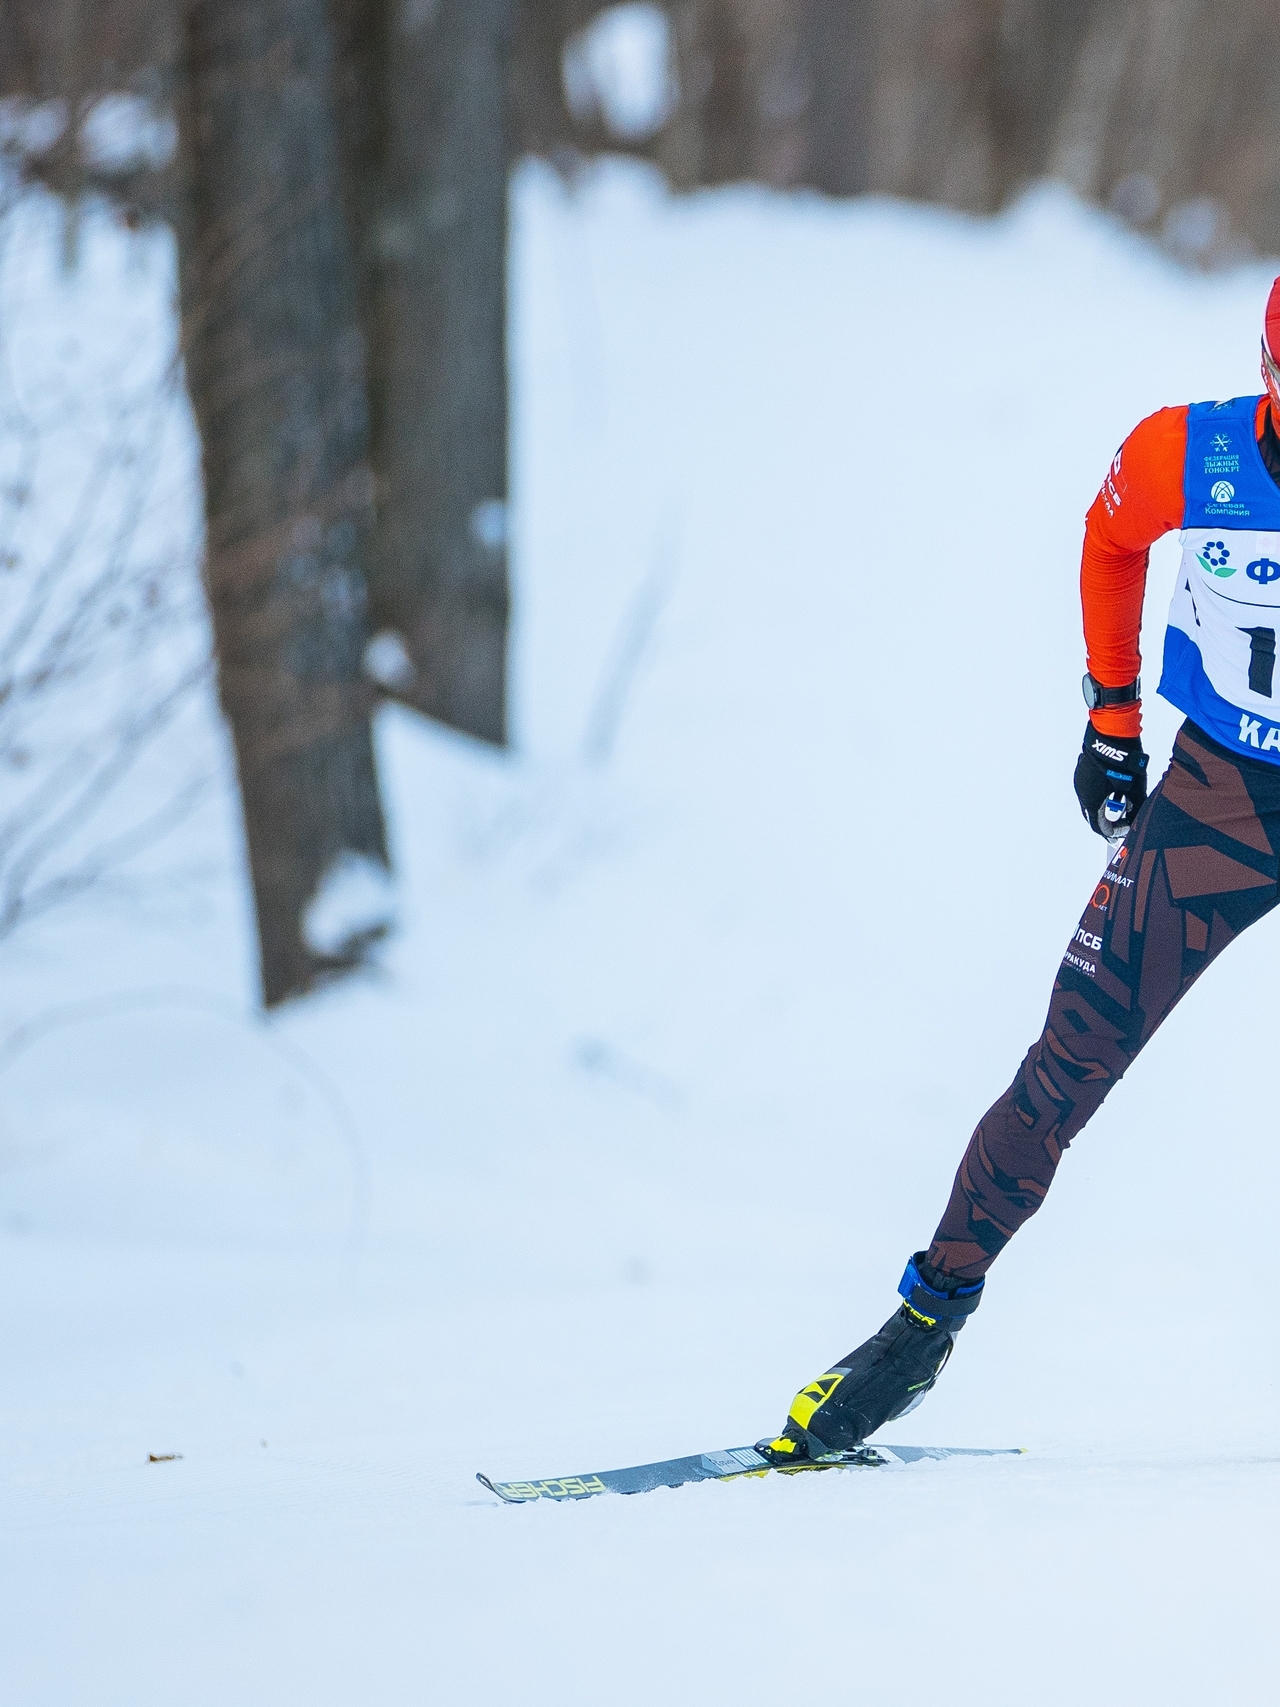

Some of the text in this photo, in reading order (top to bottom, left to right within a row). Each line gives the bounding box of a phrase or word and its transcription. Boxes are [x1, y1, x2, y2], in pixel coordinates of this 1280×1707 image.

[1203, 460, 1240, 468] ЛЫЖНЫХ
[1204, 507, 1250, 516] Компания
[1091, 739, 1129, 761] SWIX
[1074, 928, 1103, 950] ПСБ
[501, 1475, 606, 1499] FISCHER
